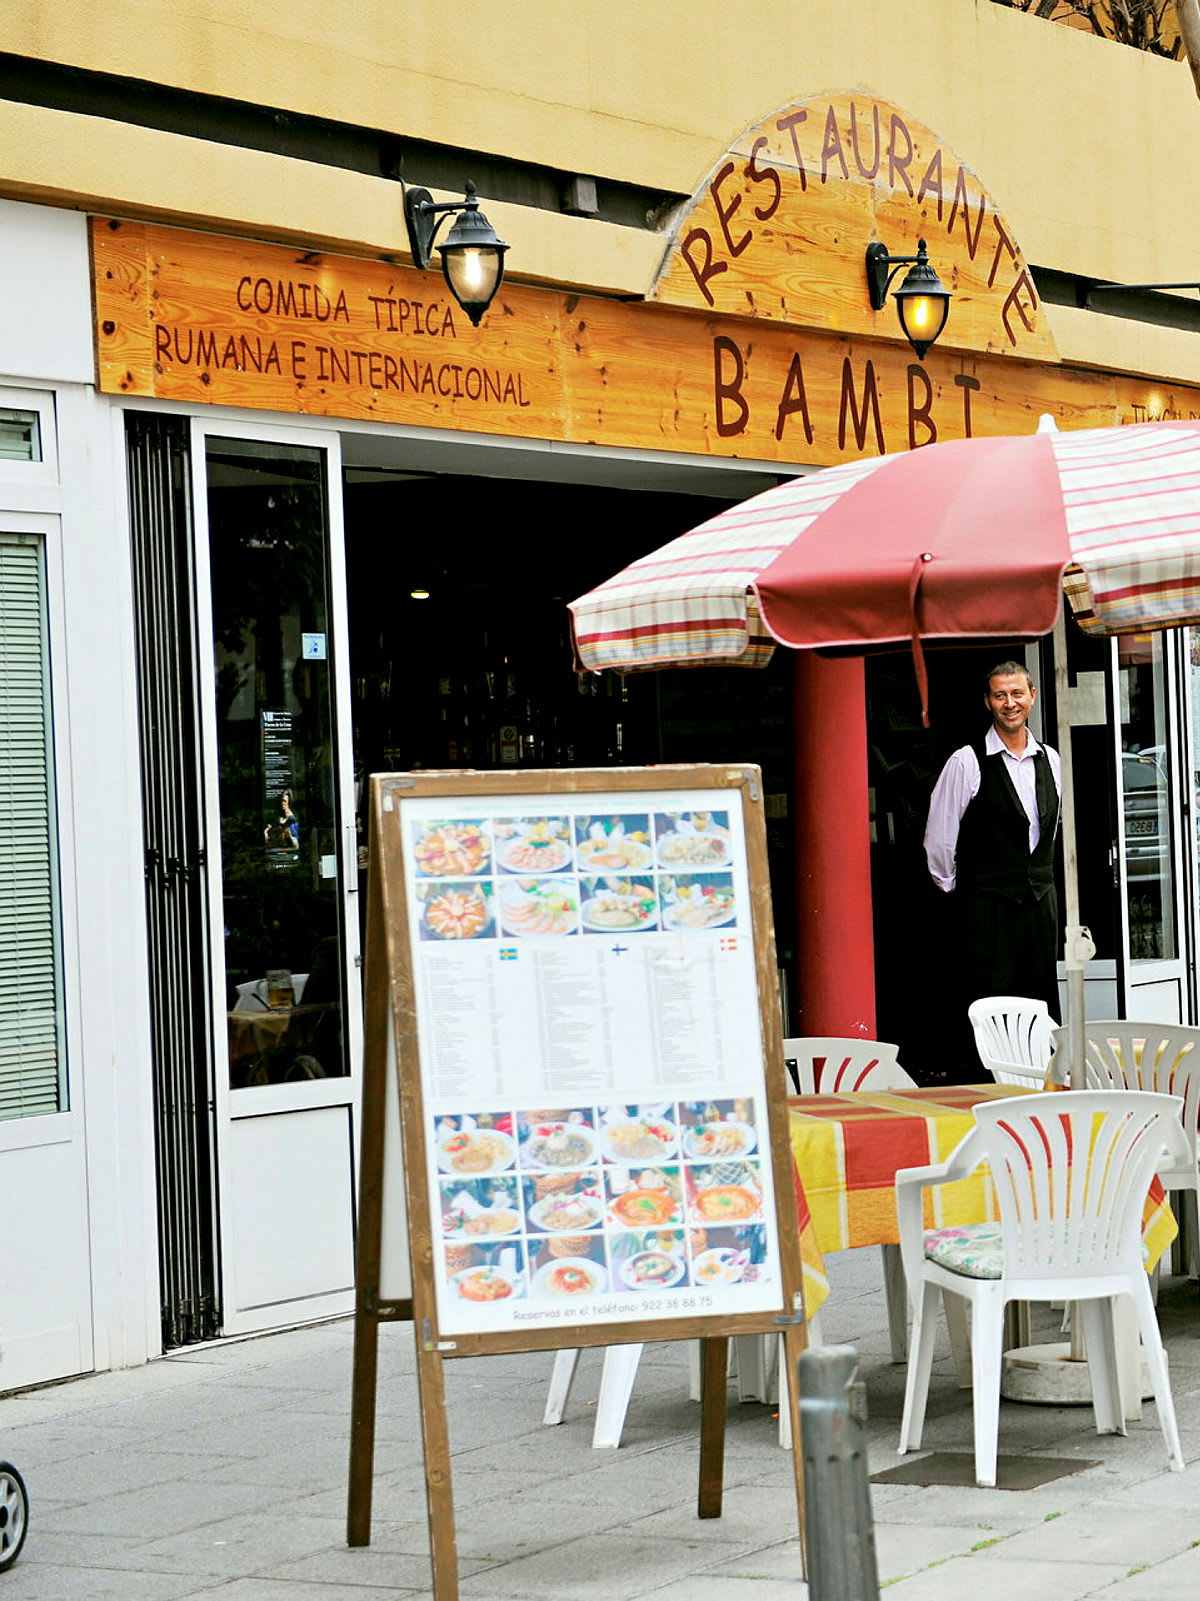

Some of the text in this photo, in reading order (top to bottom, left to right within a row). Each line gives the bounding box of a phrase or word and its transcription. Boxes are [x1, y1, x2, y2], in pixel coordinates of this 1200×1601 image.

[681, 101, 1038, 347] RESTAURANTE
[236, 276, 457, 339] COMIDA TÍPICA
[155, 324, 531, 408] RUMANA E INTERNACIONAL
[713, 335, 981, 455] BAMBI
[513, 1309, 561, 1321] Reservas
[563, 1307, 577, 1317] en
[579, 1304, 590, 1316] el
[641, 1299, 663, 1311] 922
